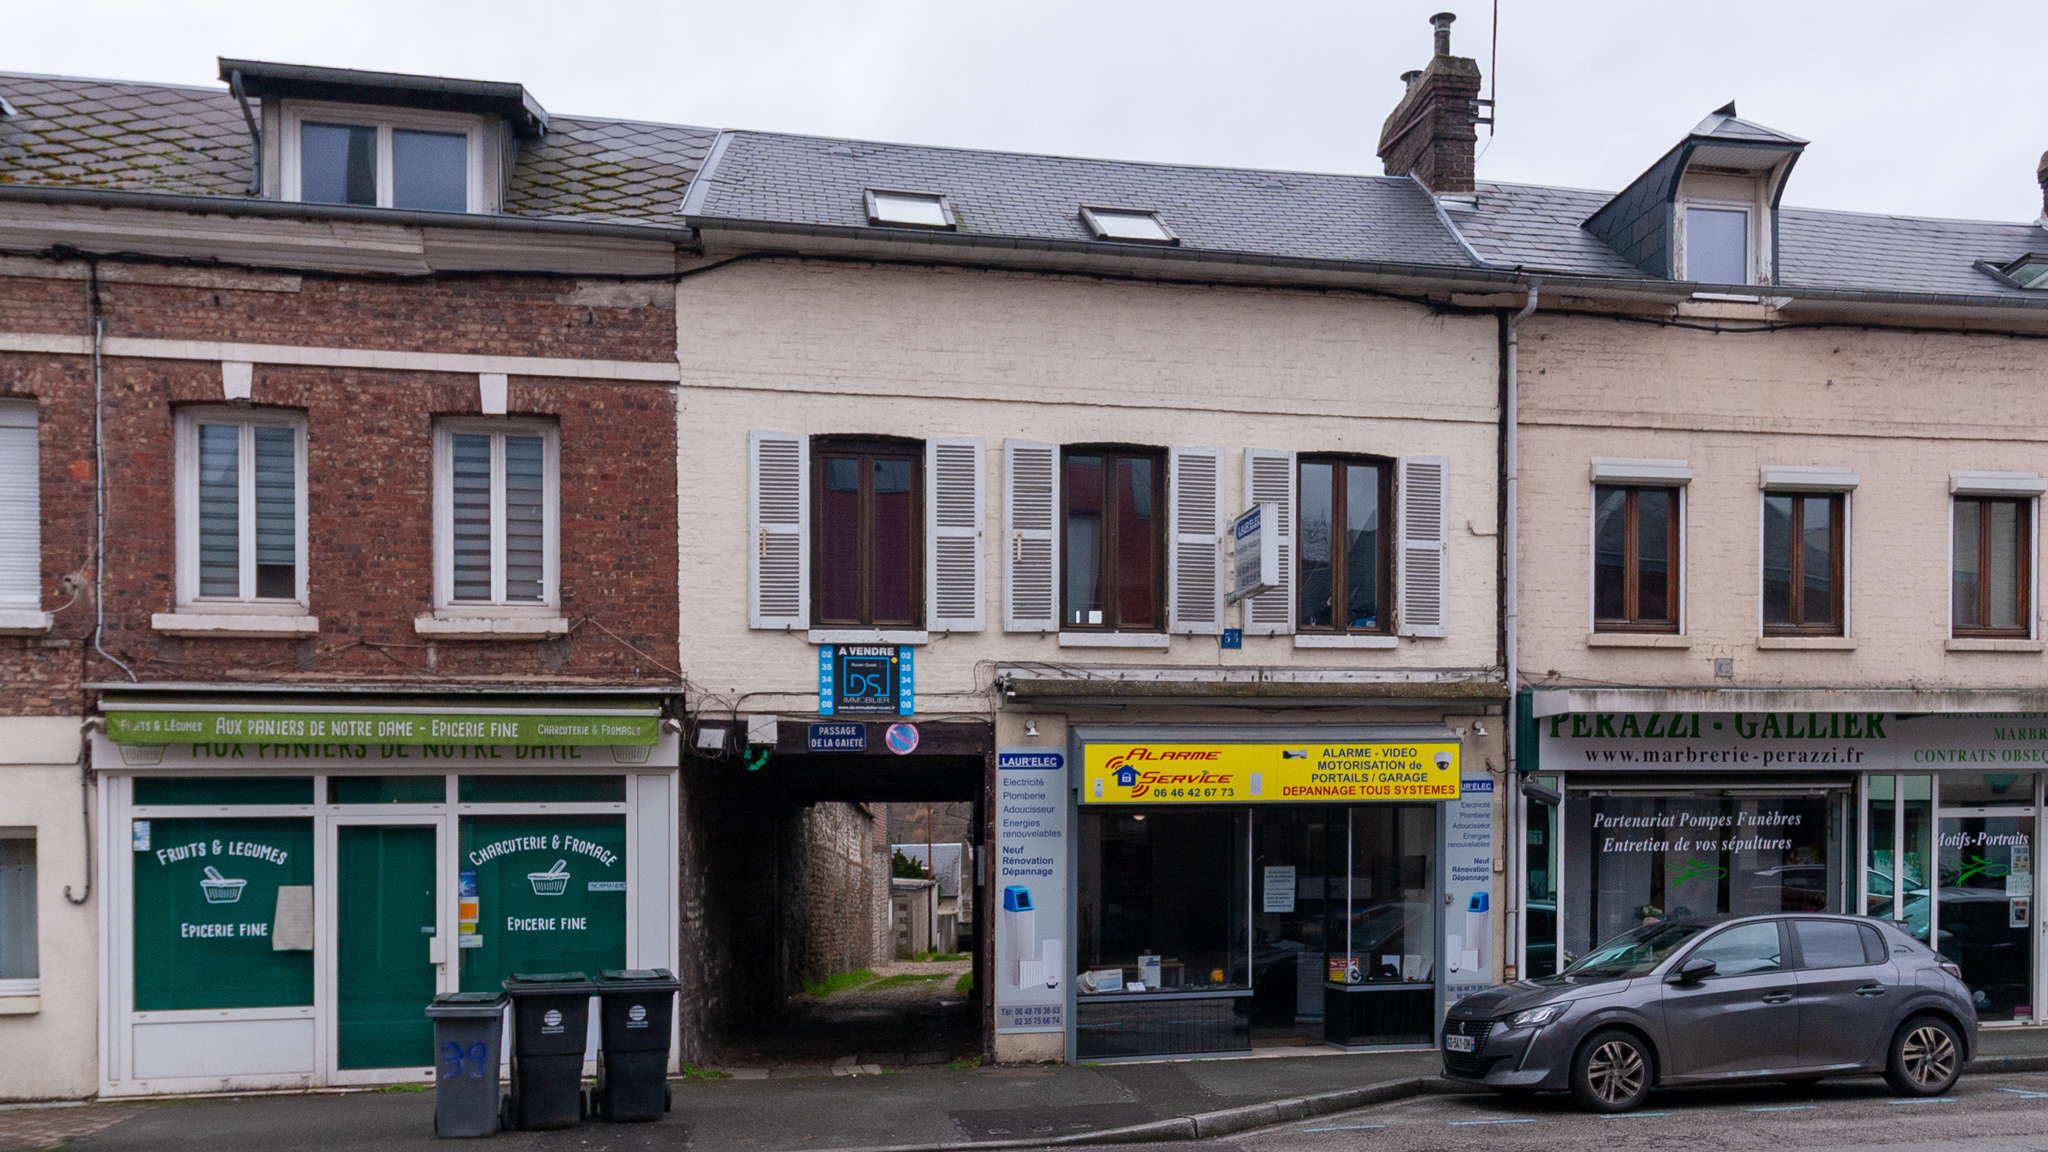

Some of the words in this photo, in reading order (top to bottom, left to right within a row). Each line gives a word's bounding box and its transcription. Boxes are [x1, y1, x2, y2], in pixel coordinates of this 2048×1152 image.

[839, 647, 847, 655] A
[849, 647, 894, 656] VENDRE
[154, 720, 160, 731] &
[215, 717, 243, 736] AUX
[248, 719, 305, 736] PANIERS
[310, 720, 326, 736] DE
[331, 720, 373, 737] NOTRE
[378, 721, 413, 737] DAME
[432, 719, 485, 737] EPICERIE
[490, 722, 518, 738] FINE
[537, 724, 589, 736] CHARCUTERIE
[592, 725, 598, 736] &
[601, 724, 641, 736] FROMAGES
[1550, 712, 1701, 738] PERAZZI
[1734, 712, 1886, 739] GALLIER
[819, 726, 856, 735] PASSAGE
[812, 739, 821, 747] DE
[824, 739, 833, 747] LA
[1125, 748, 1222, 760] ALARME
[1322, 748, 1371, 758] ALARME
[1382, 748, 1417, 757] VIDEO
[1585, 746, 1864, 766] www.marbrerie-perazzi.fr
[1914, 749, 1996, 762] CONTRATS
[1002, 757, 1057, 766] LAUR'ELEC
[1318, 761, 1405, 770] MOTORISATION
[1409, 761, 1422, 770] de
[1003, 778, 1044, 786] Electricité
[1312, 773, 1368, 783] PORTAILS
[1378, 773, 1428, 782] GARAGE
[1154, 788, 1167, 797] 06
[1170, 788, 1184, 797] 46
[1187, 788, 1200, 797] 42
[1204, 788, 1217, 796] 67
[1221, 788, 1234, 796] 73
[1282, 786, 1356, 796] DEPANNAGE
[1359, 786, 1391, 795] TOUS
[1394, 785, 1455, 795] SYSTEMES
[1003, 792, 1045, 800] Plomberie
[1003, 806, 1055, 814] Adoucisseur
[1003, 819, 1040, 828] Energies
[1593, 812, 1675, 828] Partenariat
[1679, 813, 1732, 830] Pompes
[1736, 811, 1802, 827] Funèbres
[1003, 830, 1062, 838] renouvelables
[1602, 837, 1669, 853] Entretien
[1674, 837, 1690, 851] de
[1695, 841, 1716, 851] vos
[1721, 835, 1792, 854] sépultures
[156, 842, 206, 866] FRUITS
[212, 839, 223, 855] &
[228, 841, 288, 865] LEGUMES
[469, 836, 548, 866] CHARCUTERIE
[551, 834, 560, 849] &
[564, 835, 618, 867] FROMAGE
[1002, 846, 1024, 854] Neuf
[1002, 857, 1054, 865] Rénovation
[1002, 867, 1053, 877] Dépannage
[1452, 874, 1489, 882] Dépannage
[507, 917, 556, 931] EPICERIE
[560, 917, 587, 930] FINE
[181, 923, 234, 938] EPICERIE
[239, 923, 268, 937] FINE
[1034, 1007, 1041, 1015] 78
[1033, 1017, 1041, 1025] 75
[441, 1040, 489, 1080] 39
